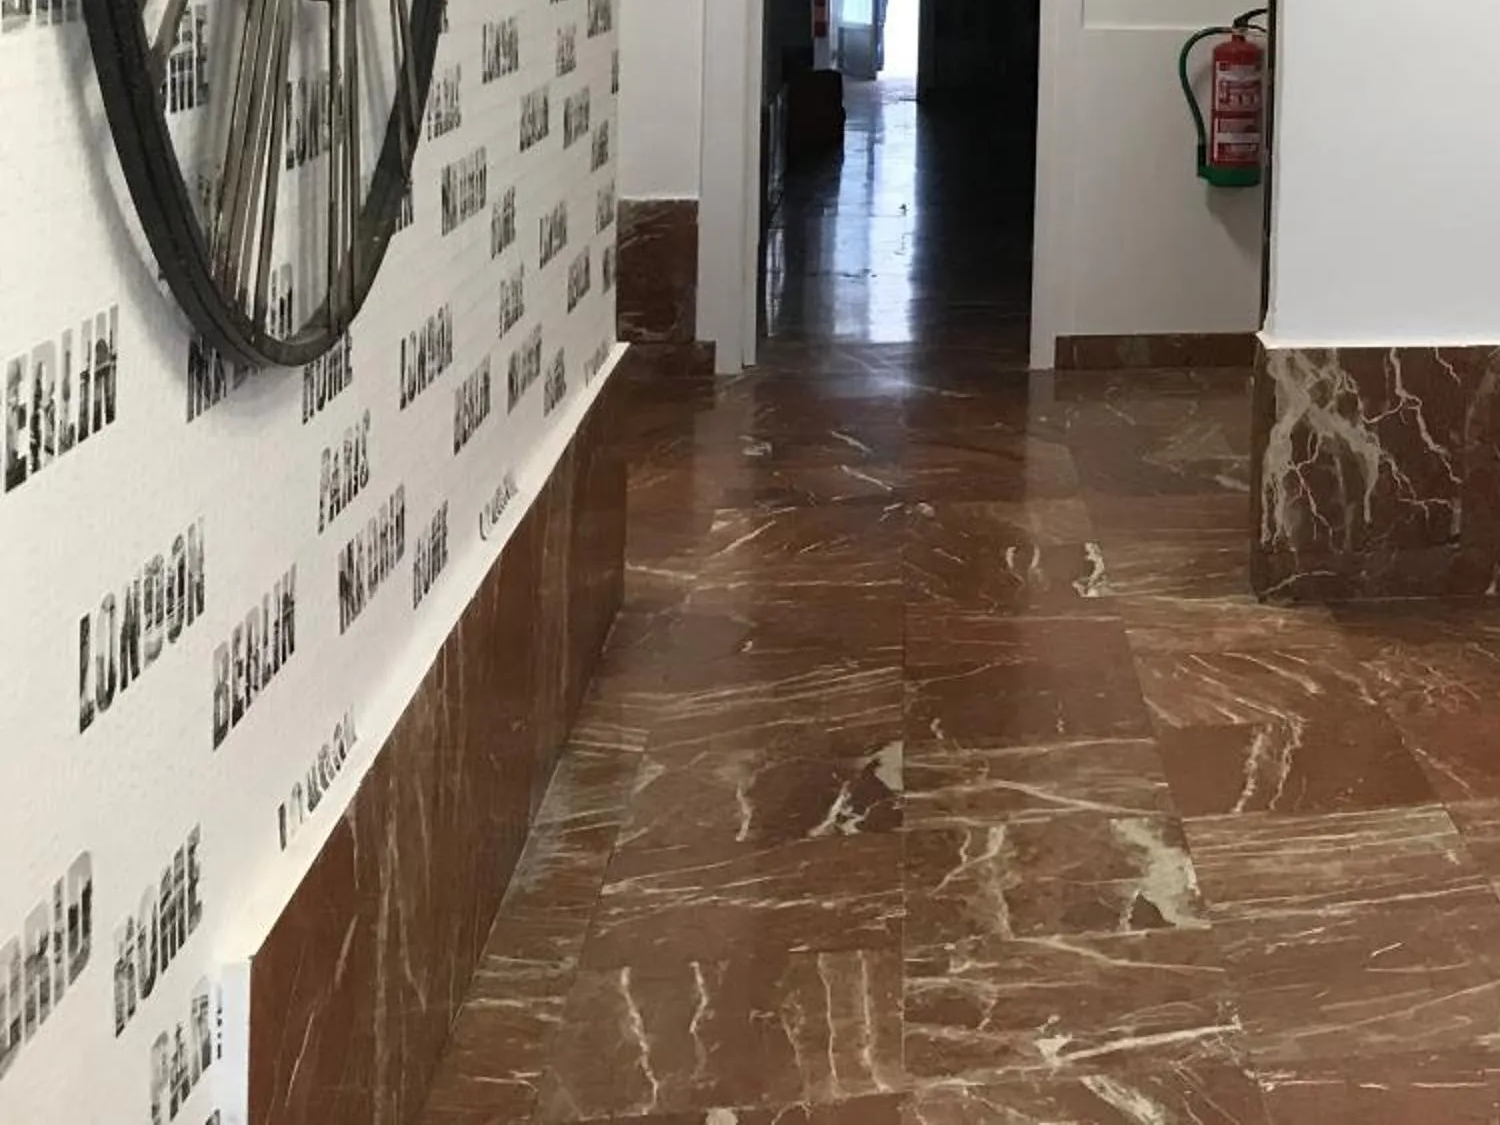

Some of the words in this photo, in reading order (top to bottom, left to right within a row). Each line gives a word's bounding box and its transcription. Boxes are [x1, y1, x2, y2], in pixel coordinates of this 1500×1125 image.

[0, 303, 119, 493] ERLIN
[400, 302, 453, 411] LONDON
[318, 408, 370, 537] PARIS
[339, 481, 405, 636] MADRID
[413, 498, 448, 611] ROME
[79, 517, 205, 736] LONDON
[213, 562, 297, 752] BERLIN
[113, 822, 202, 1039] ROME
